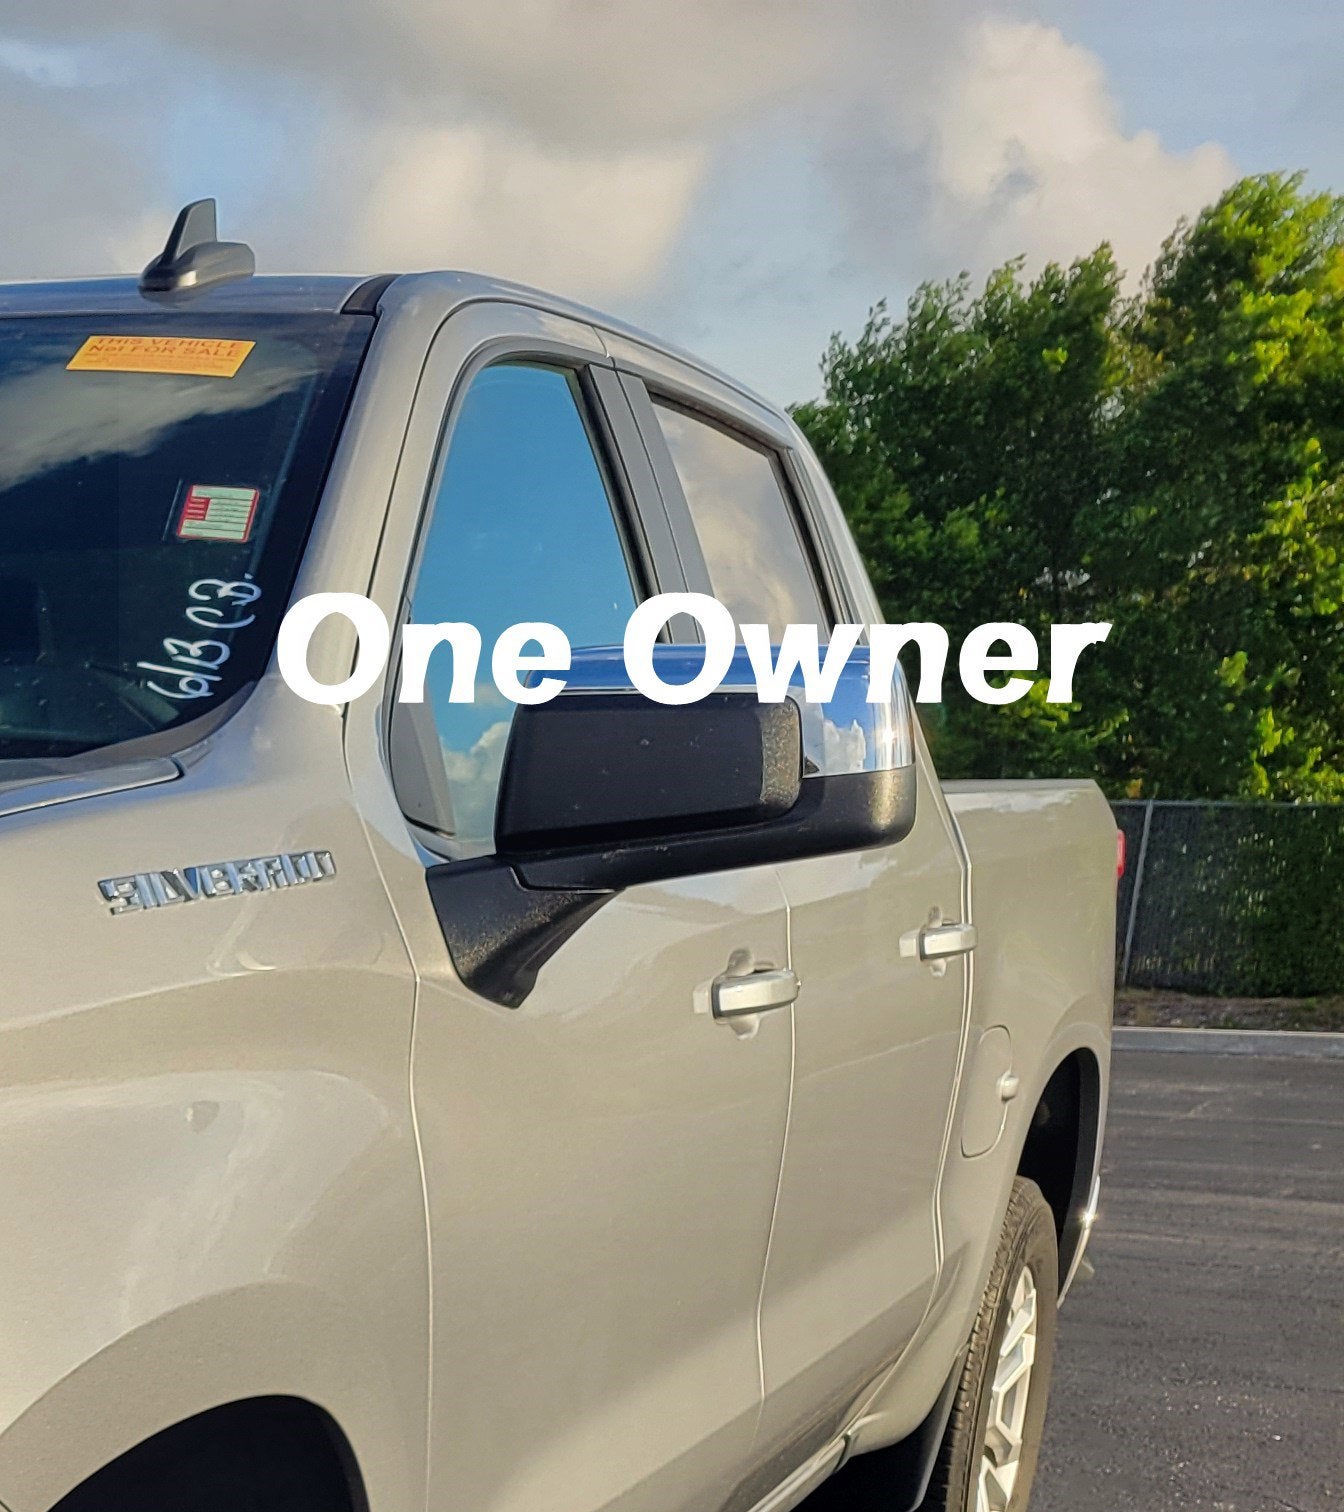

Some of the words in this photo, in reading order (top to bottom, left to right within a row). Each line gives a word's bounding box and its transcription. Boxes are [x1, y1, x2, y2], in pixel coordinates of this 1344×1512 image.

[128, 345, 174, 355] FOR
[182, 346, 241, 358] SALE
[97, 850, 337, 916] SILVERADO
